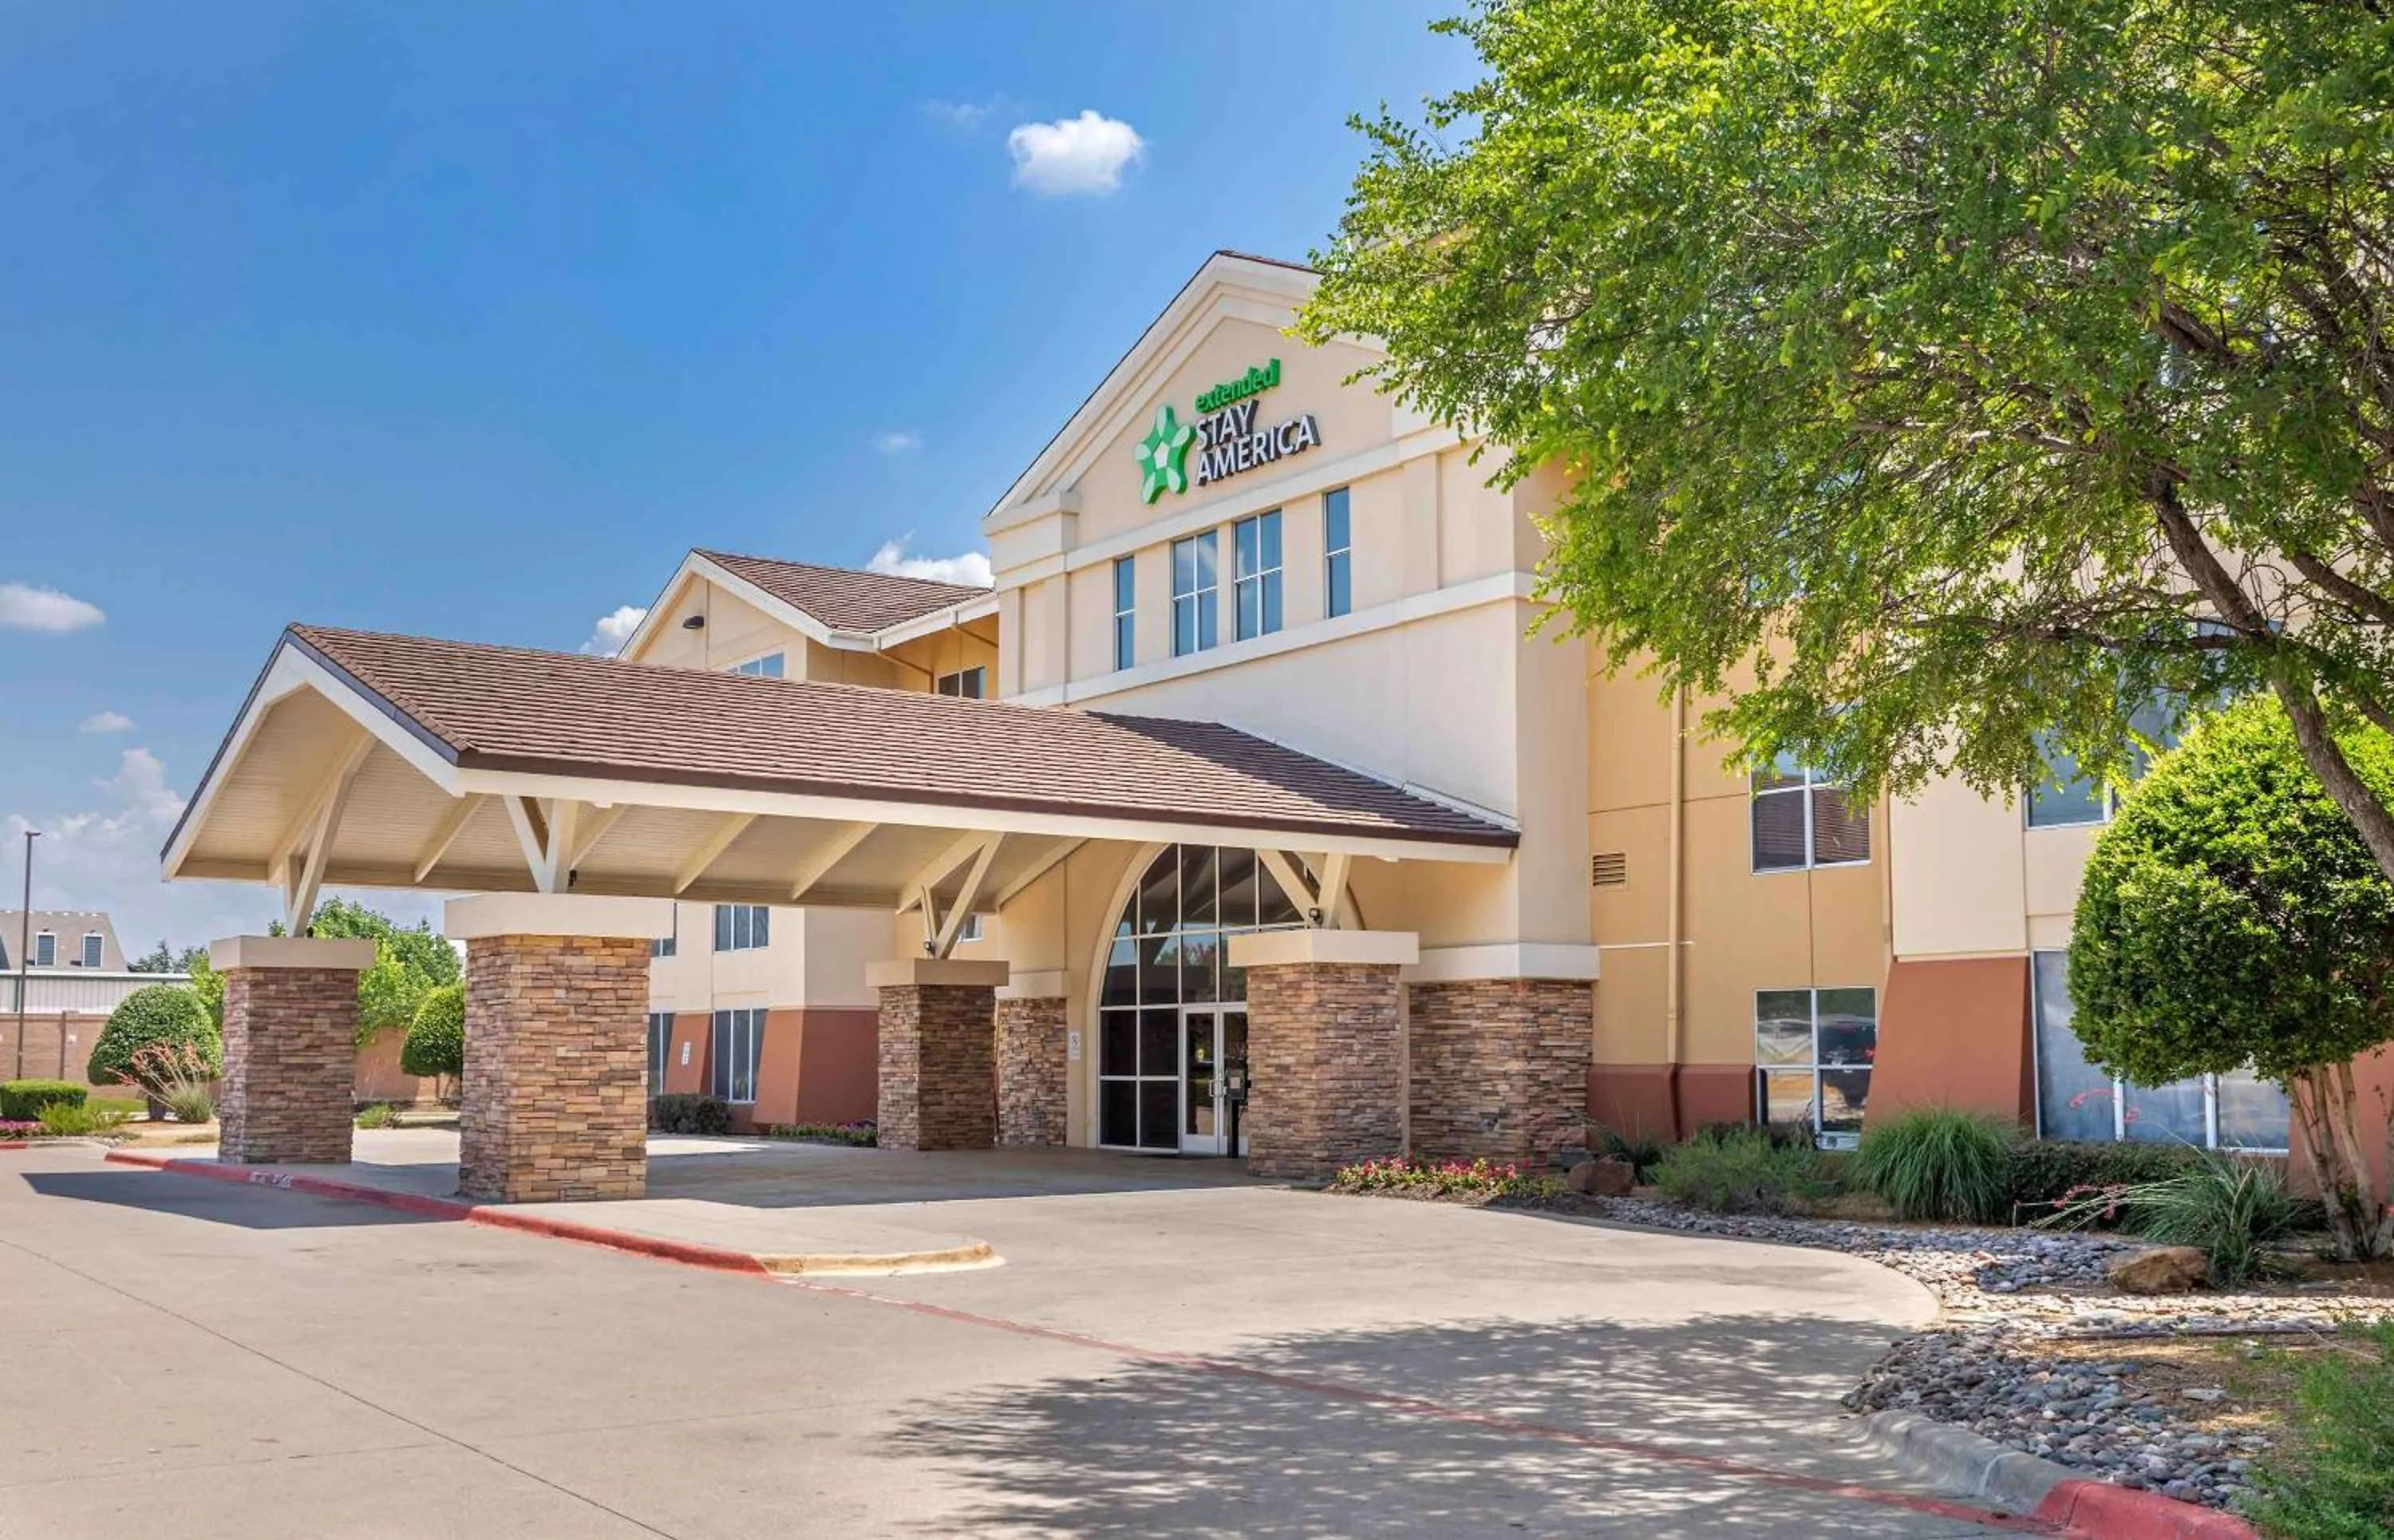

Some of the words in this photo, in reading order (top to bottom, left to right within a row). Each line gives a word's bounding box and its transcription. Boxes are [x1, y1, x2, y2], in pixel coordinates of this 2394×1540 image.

[1195, 357, 1280, 413] extended
[1196, 399, 1259, 452] STAY
[1197, 414, 1321, 486] AMERICA
